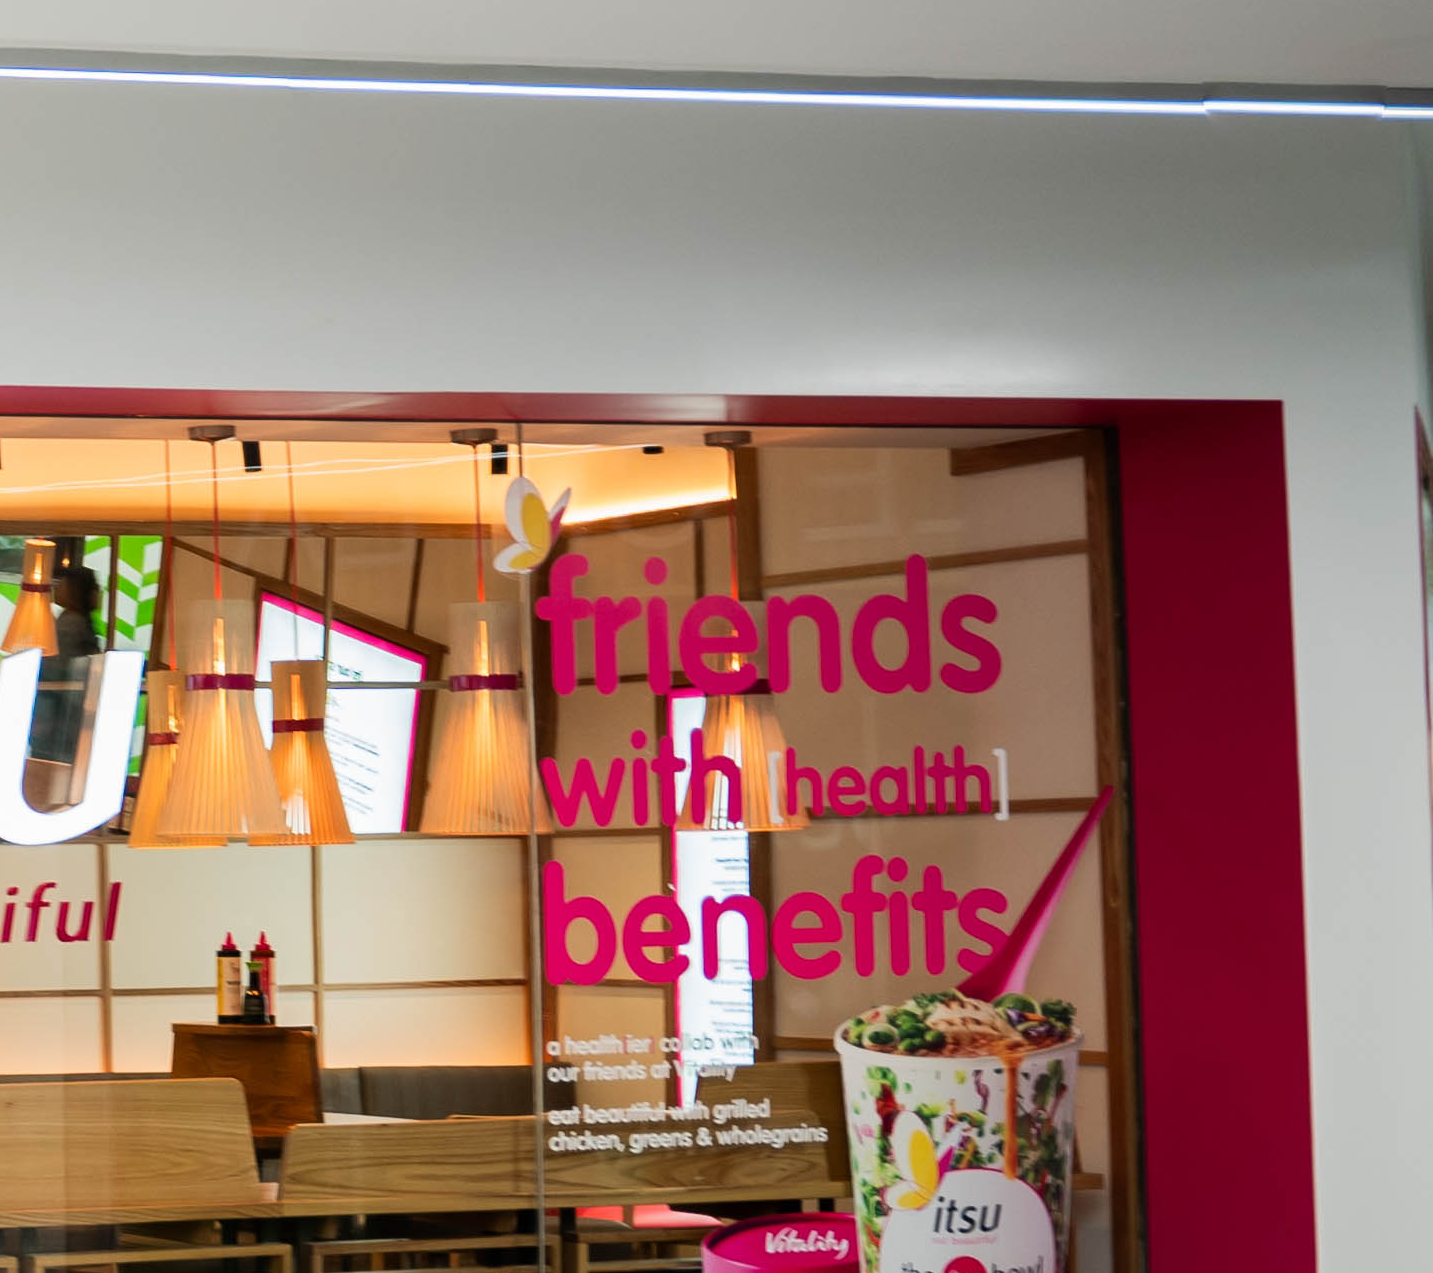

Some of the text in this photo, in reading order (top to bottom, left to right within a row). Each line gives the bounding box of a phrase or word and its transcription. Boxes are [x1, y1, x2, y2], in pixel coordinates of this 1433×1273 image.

[535, 554, 1001, 695] friends
[540, 728, 742, 827] with
[543, 855, 1009, 985] benefits
[546, 1040, 561, 1056] a
[721, 1033, 759, 1051] with
[547, 1066, 580, 1082] our
[583, 1061, 647, 1081] friends
[651, 1062, 671, 1079] at
[548, 1098, 771, 1126] eat beautiful with grilled
[548, 1124, 829, 1154] chicken, greens & wholegrains
[932, 1196, 1002, 1233] itsu
[765, 1227, 849, 1260] Vitality
